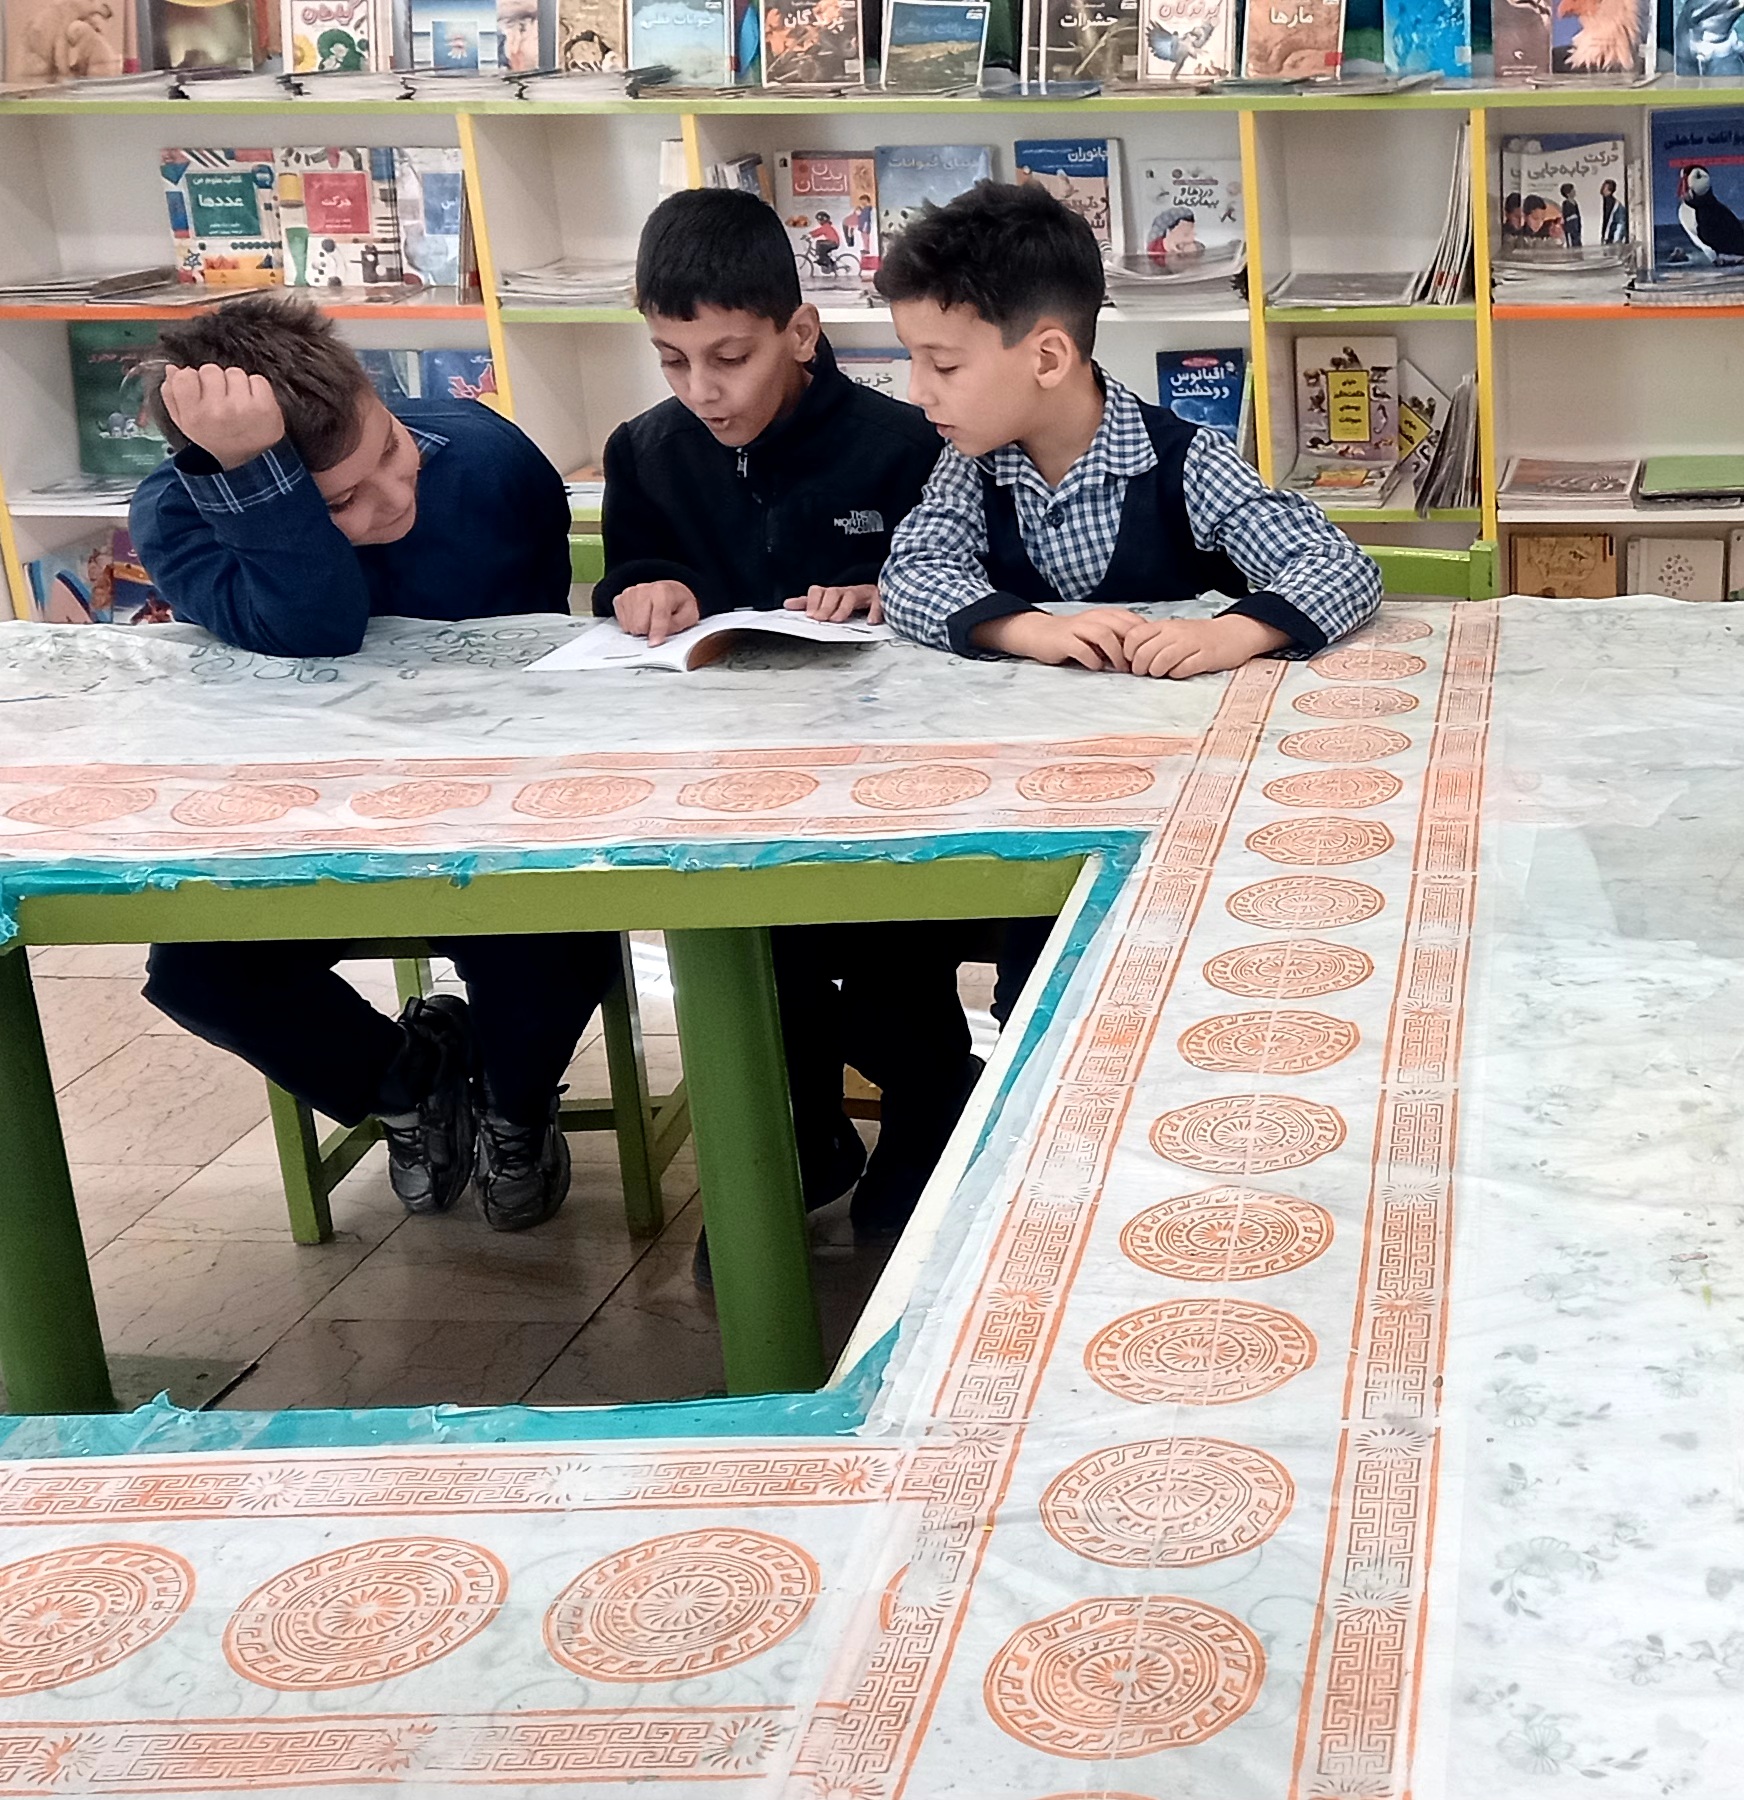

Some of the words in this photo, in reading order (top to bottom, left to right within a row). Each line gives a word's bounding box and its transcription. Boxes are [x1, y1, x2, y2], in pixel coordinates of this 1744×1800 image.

[783, 9, 845, 34] پرندگان
[1060, 13, 1119, 31] حشرات
[1269, 6, 1314, 28] مارها
[1583, 151, 1619, 167] حرکت
[811, 162, 843, 180] بدن
[794, 174, 848, 193] انسان
[198, 194, 245, 207] عددها
[1170, 366, 1225, 386] اقیانوس
